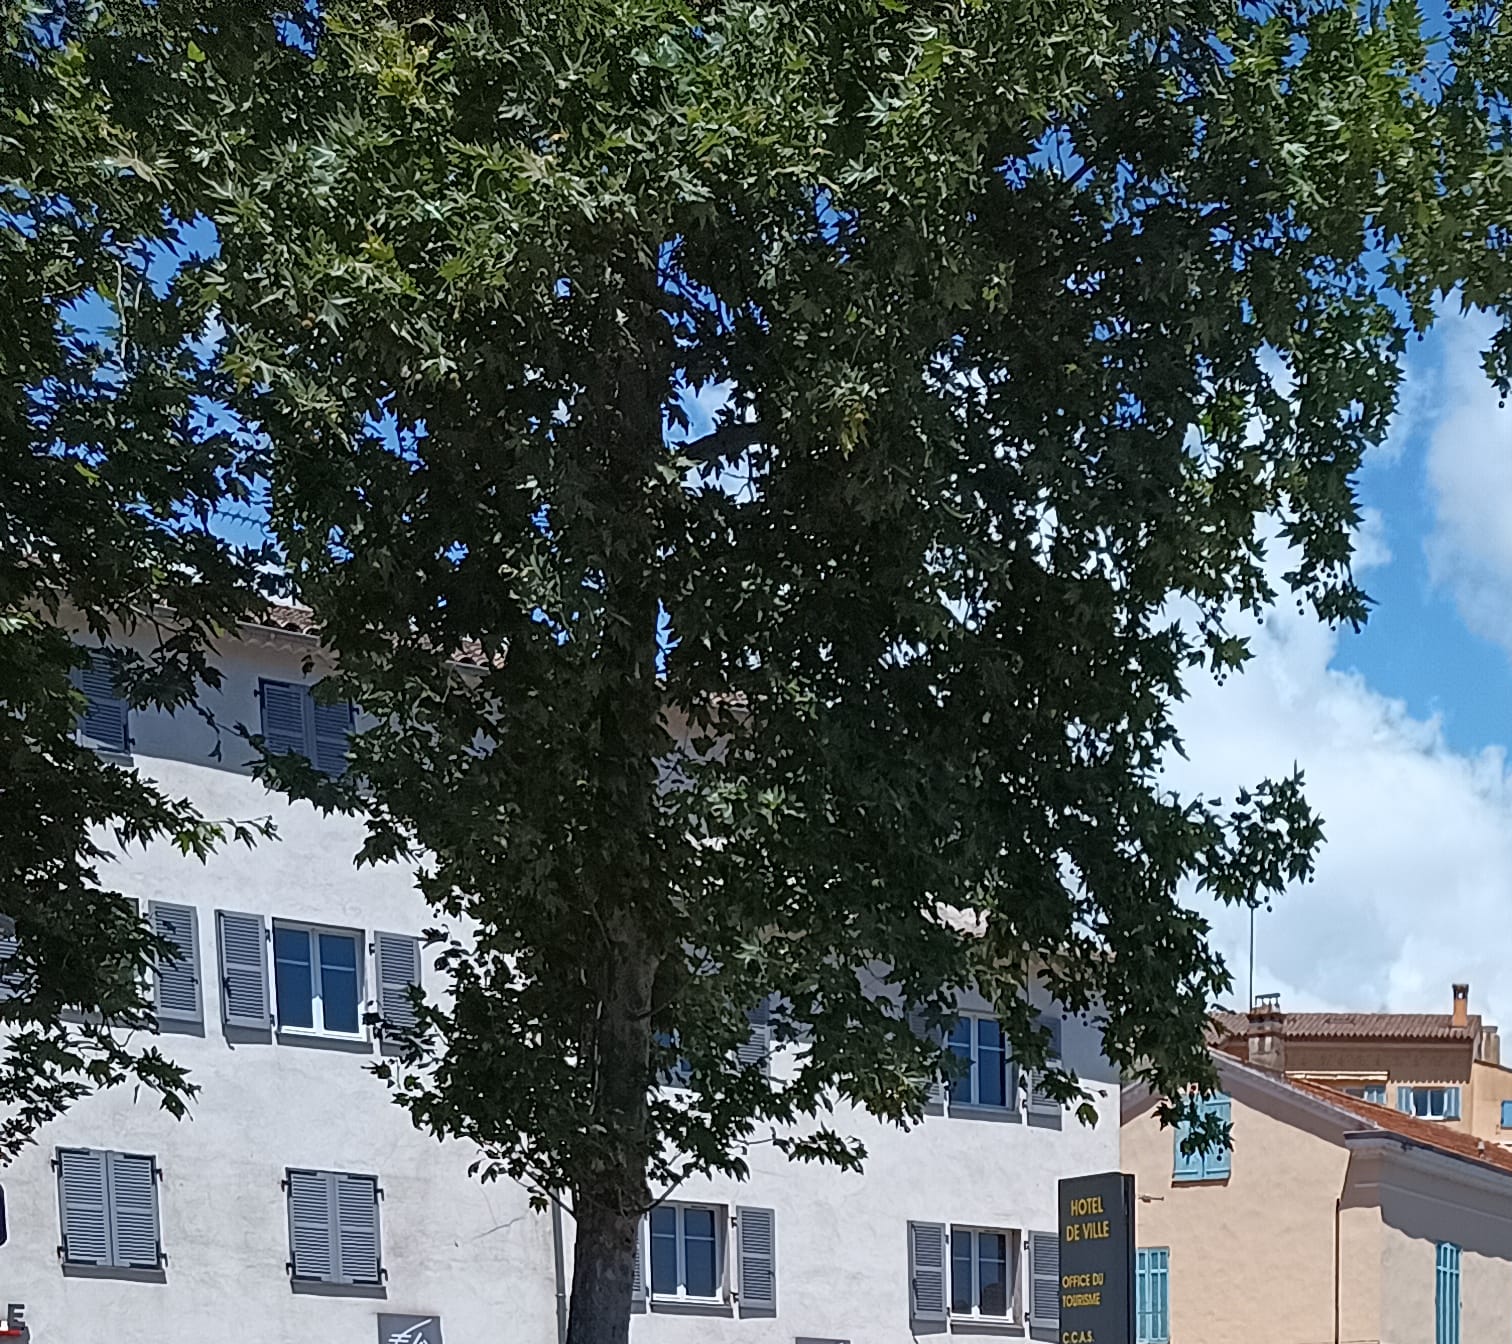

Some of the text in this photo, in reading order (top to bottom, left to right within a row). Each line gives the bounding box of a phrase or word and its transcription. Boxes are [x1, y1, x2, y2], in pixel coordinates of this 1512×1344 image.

[1070, 1196, 1104, 1216] HOTEL
[1066, 1220, 1110, 1242] DE VILLE
[1062, 1272, 1104, 1289] OFFICE DU
[1062, 1292, 1101, 1308] TOURISME
